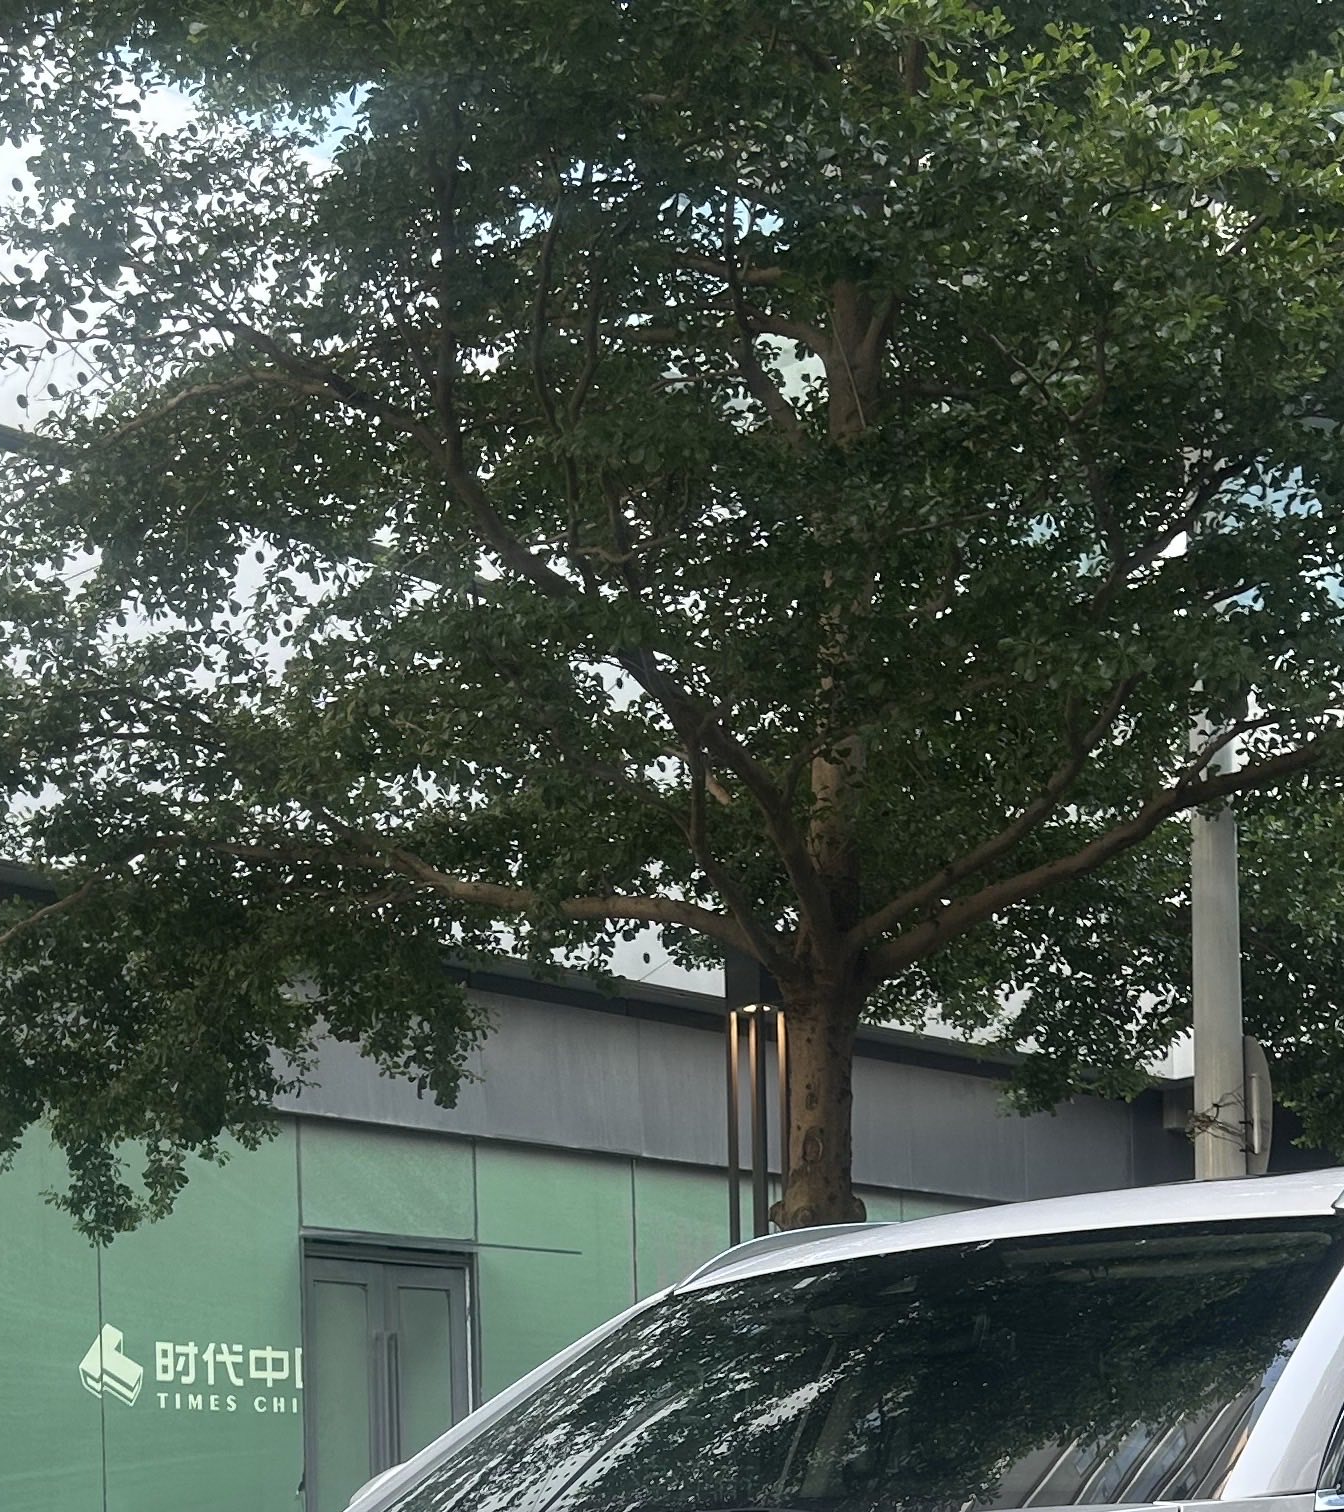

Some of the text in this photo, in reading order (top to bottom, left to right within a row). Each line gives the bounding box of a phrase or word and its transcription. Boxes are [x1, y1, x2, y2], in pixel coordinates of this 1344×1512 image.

[156, 1341, 303, 1389] 时代中
[157, 1392, 237, 1412] TIMES
